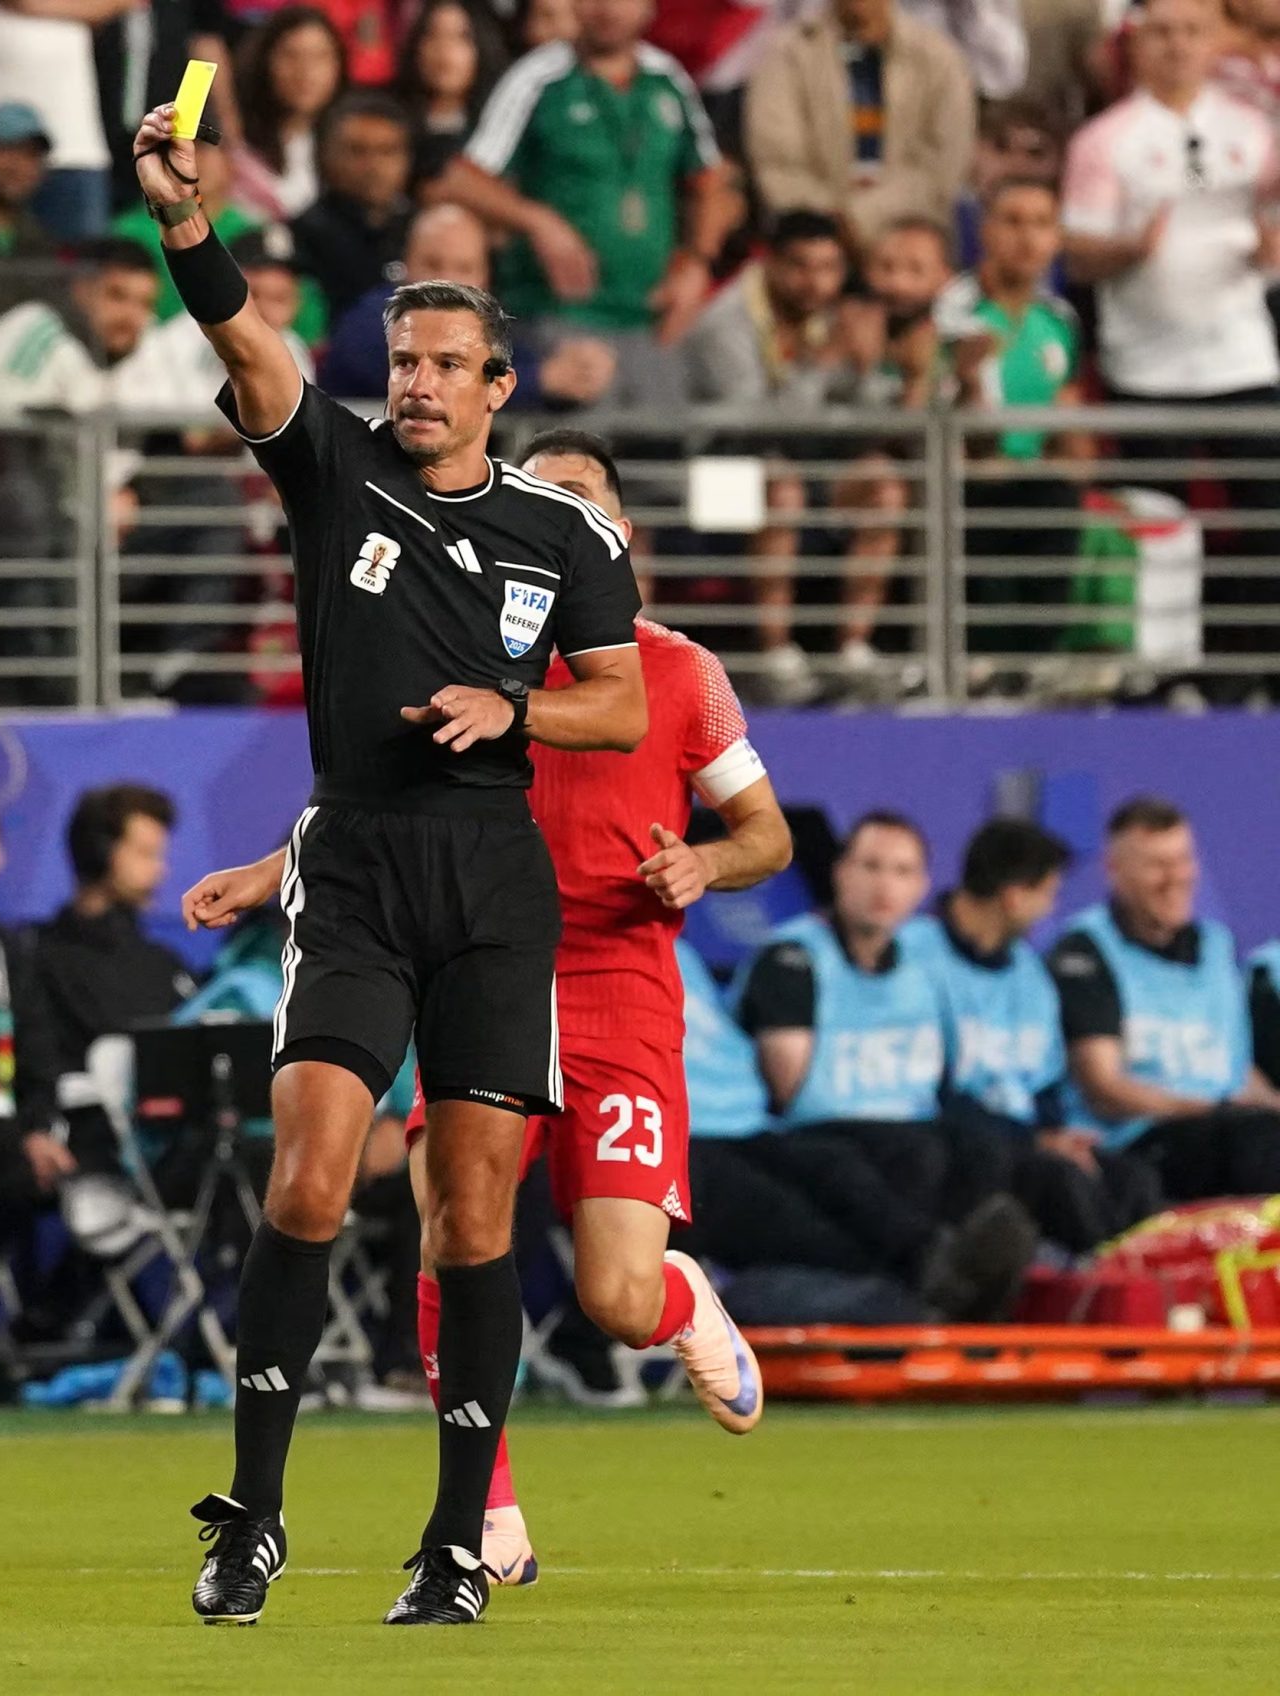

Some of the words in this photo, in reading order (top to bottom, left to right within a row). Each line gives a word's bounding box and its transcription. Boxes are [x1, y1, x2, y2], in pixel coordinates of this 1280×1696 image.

[511, 586, 548, 612] FIFA
[505, 613, 540, 633] REFEREE
[596, 1093, 663, 1168] 23
